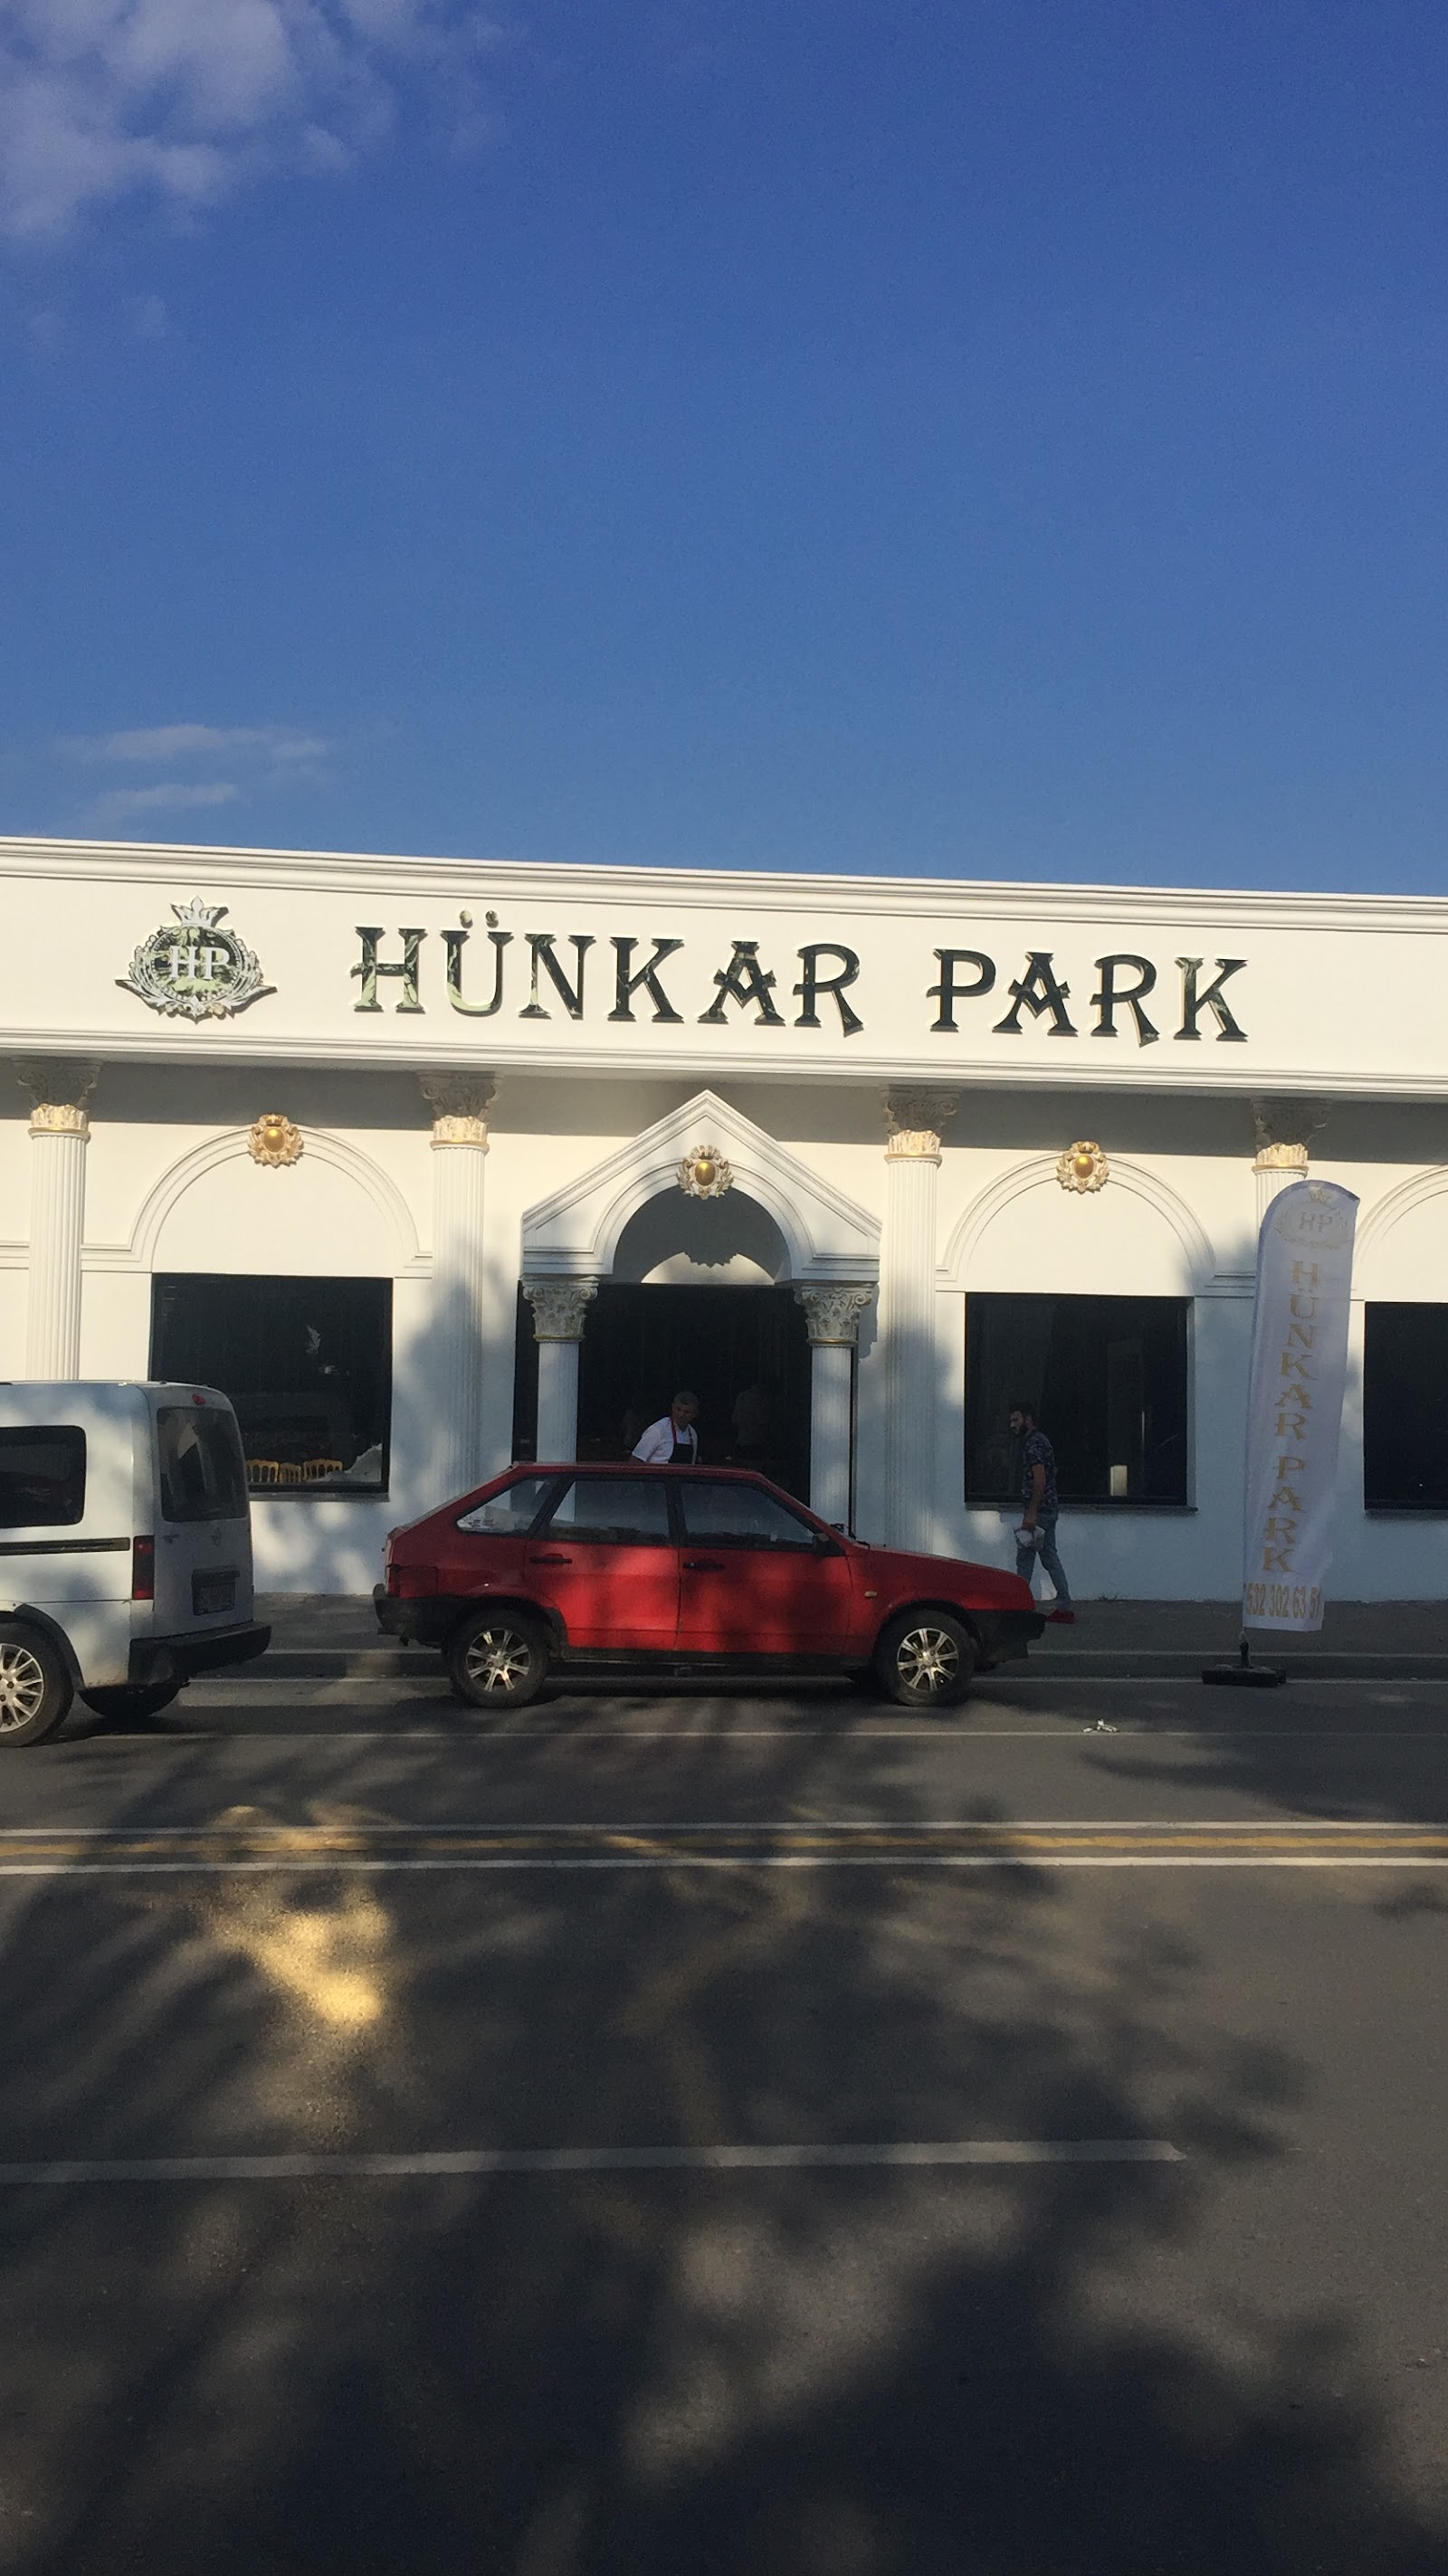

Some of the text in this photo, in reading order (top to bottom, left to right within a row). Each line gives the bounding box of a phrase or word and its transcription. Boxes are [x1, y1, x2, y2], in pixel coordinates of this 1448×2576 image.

[169, 945, 230, 981] HP
[350, 909, 1250, 1048] HÜNKAR PARK
[1300, 1212, 1334, 1233] HP
[1261, 1259, 1319, 1573] HÜNKAR PARK
[1243, 1583, 1266, 1616] 532
